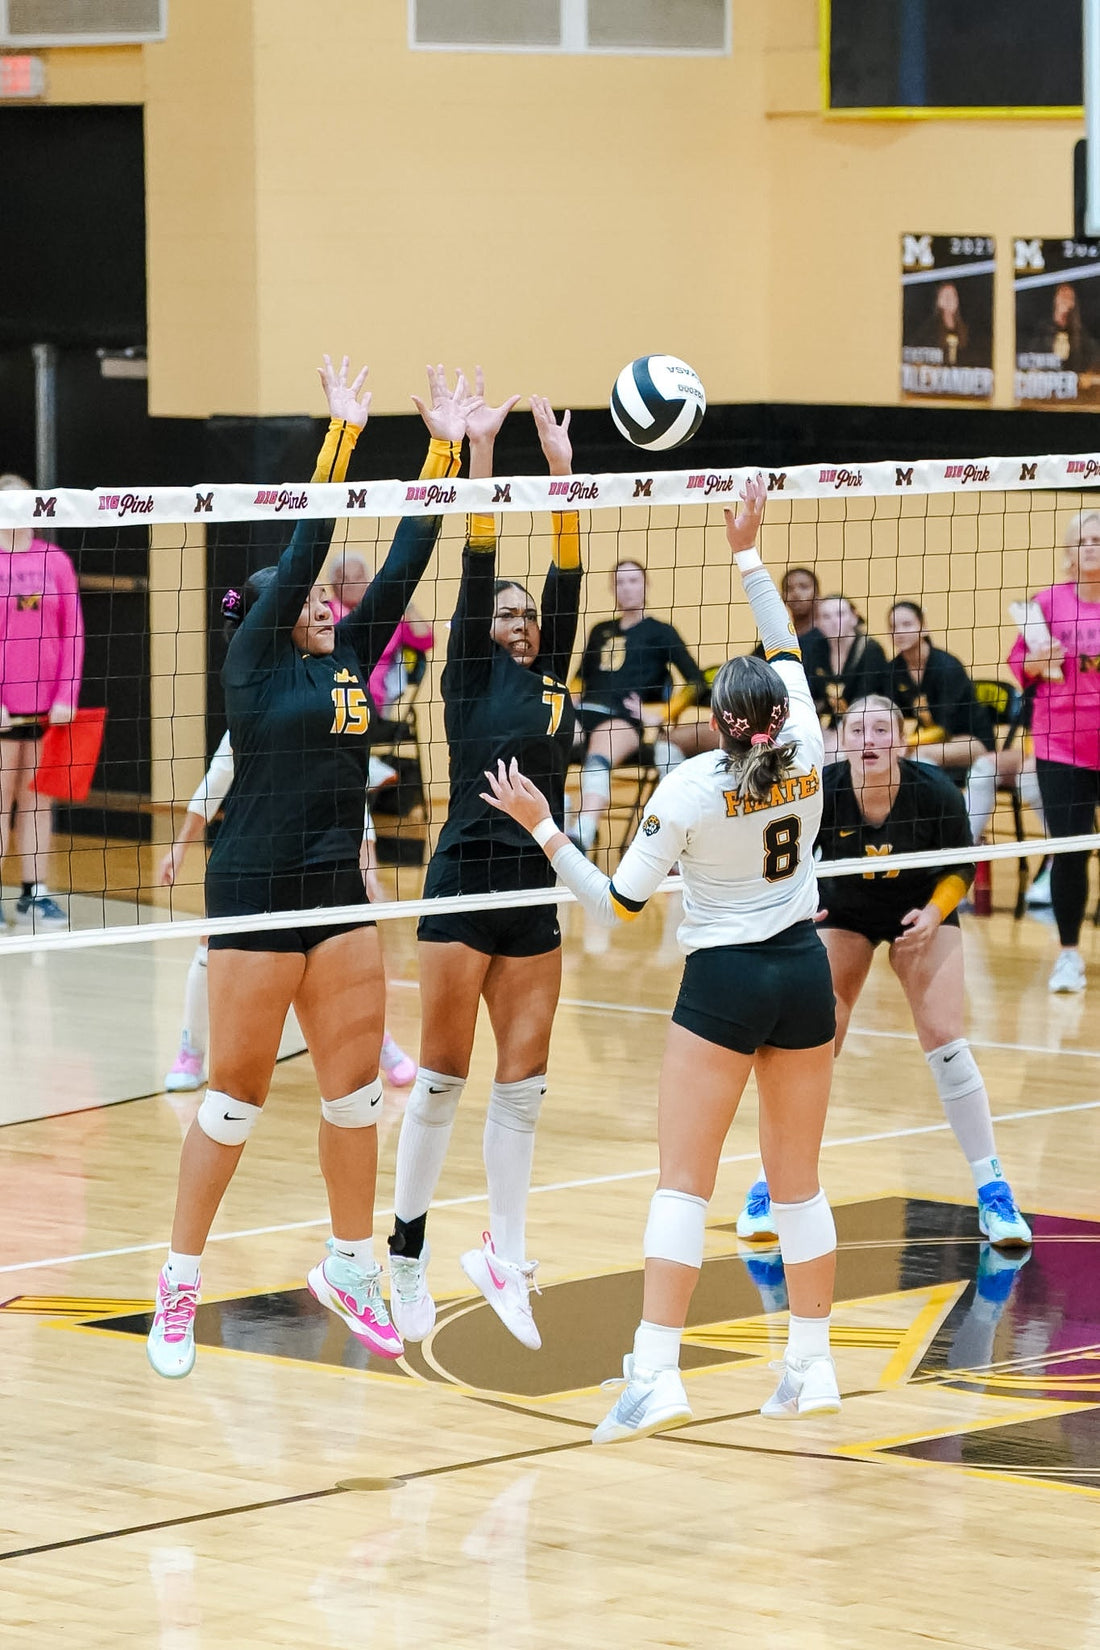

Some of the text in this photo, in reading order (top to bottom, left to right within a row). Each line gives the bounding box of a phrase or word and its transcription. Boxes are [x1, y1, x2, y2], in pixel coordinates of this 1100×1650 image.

[903, 234, 935, 267] M
[1014, 239, 1045, 269] M
[767, 472, 787, 491] M
[818, 468, 864, 489] DIG Pink
[895, 467, 914, 486] M
[944, 464, 991, 484] DIG Pink
[1019, 463, 1038, 481] M
[491, 483, 512, 503] M
[548, 481, 599, 503] DIG Pink
[632, 478, 654, 497] M
[686, 474, 734, 496] DIG Pink
[98, 494, 154, 518] DIG Pink
[194, 492, 215, 513] M
[253, 489, 308, 512] DIG Pink
[346, 488, 368, 509] M
[405, 485, 457, 507] DIG Pink
[33, 497, 57, 517] M
[330, 688, 370, 735] 15
[542, 690, 565, 737] 7
[762, 813, 802, 884] 8
